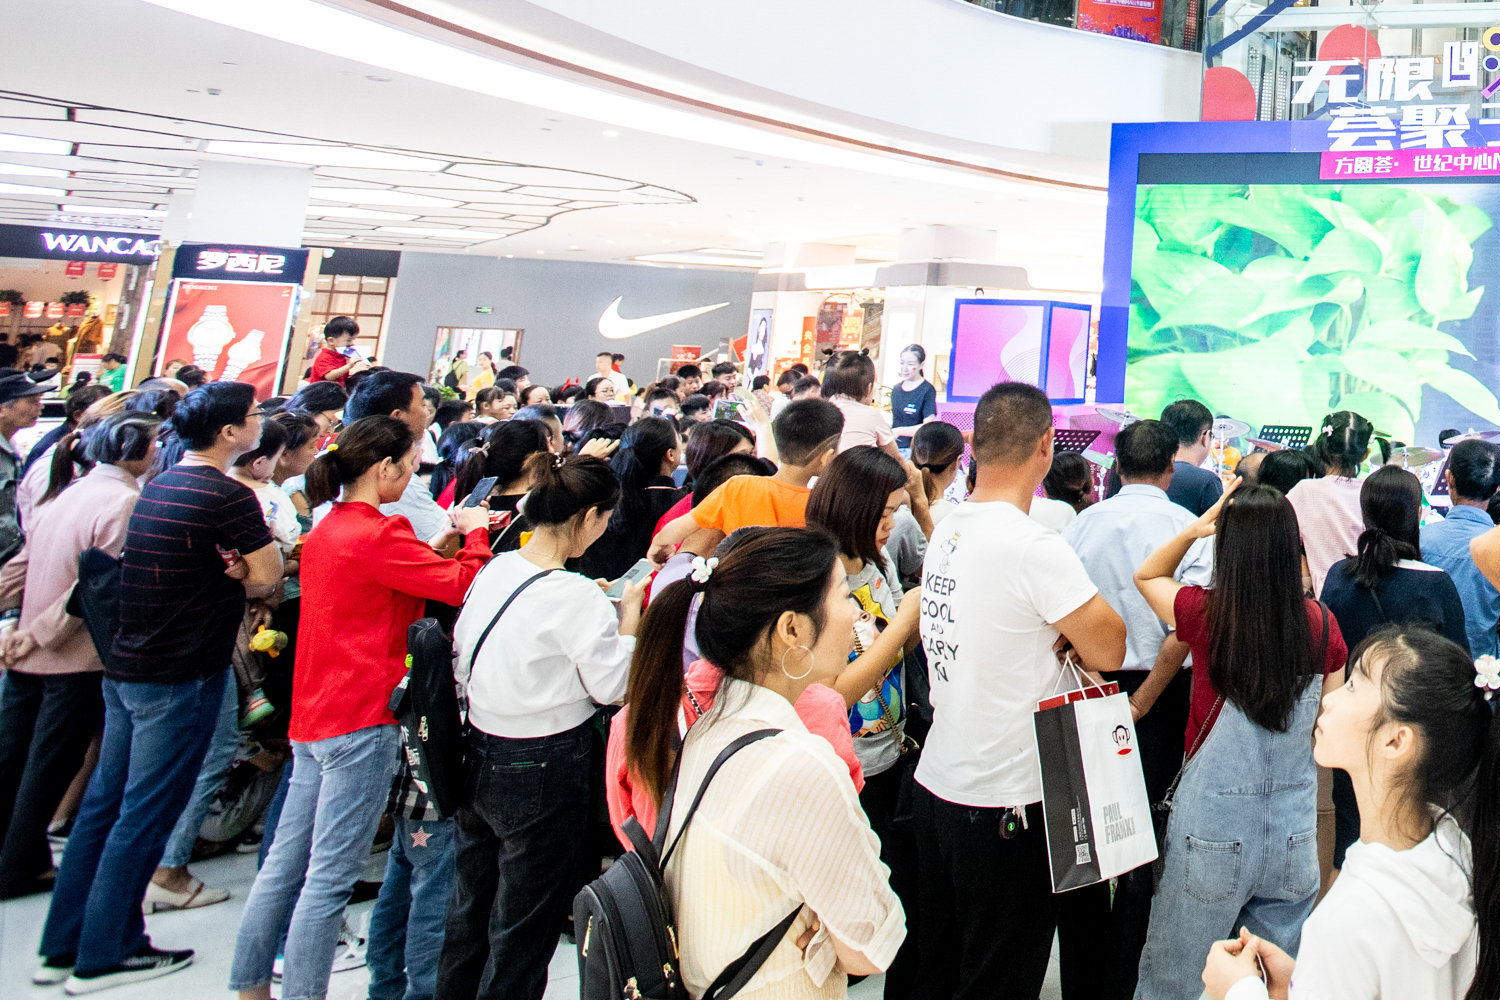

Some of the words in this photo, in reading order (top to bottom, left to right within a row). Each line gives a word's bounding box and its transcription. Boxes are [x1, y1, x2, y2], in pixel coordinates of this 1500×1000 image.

[196, 251, 286, 274] 罗西尼
[925, 571, 956, 596] KEEP
[922, 597, 955, 623] COOL
[1103, 802, 1123, 825] PAUL
